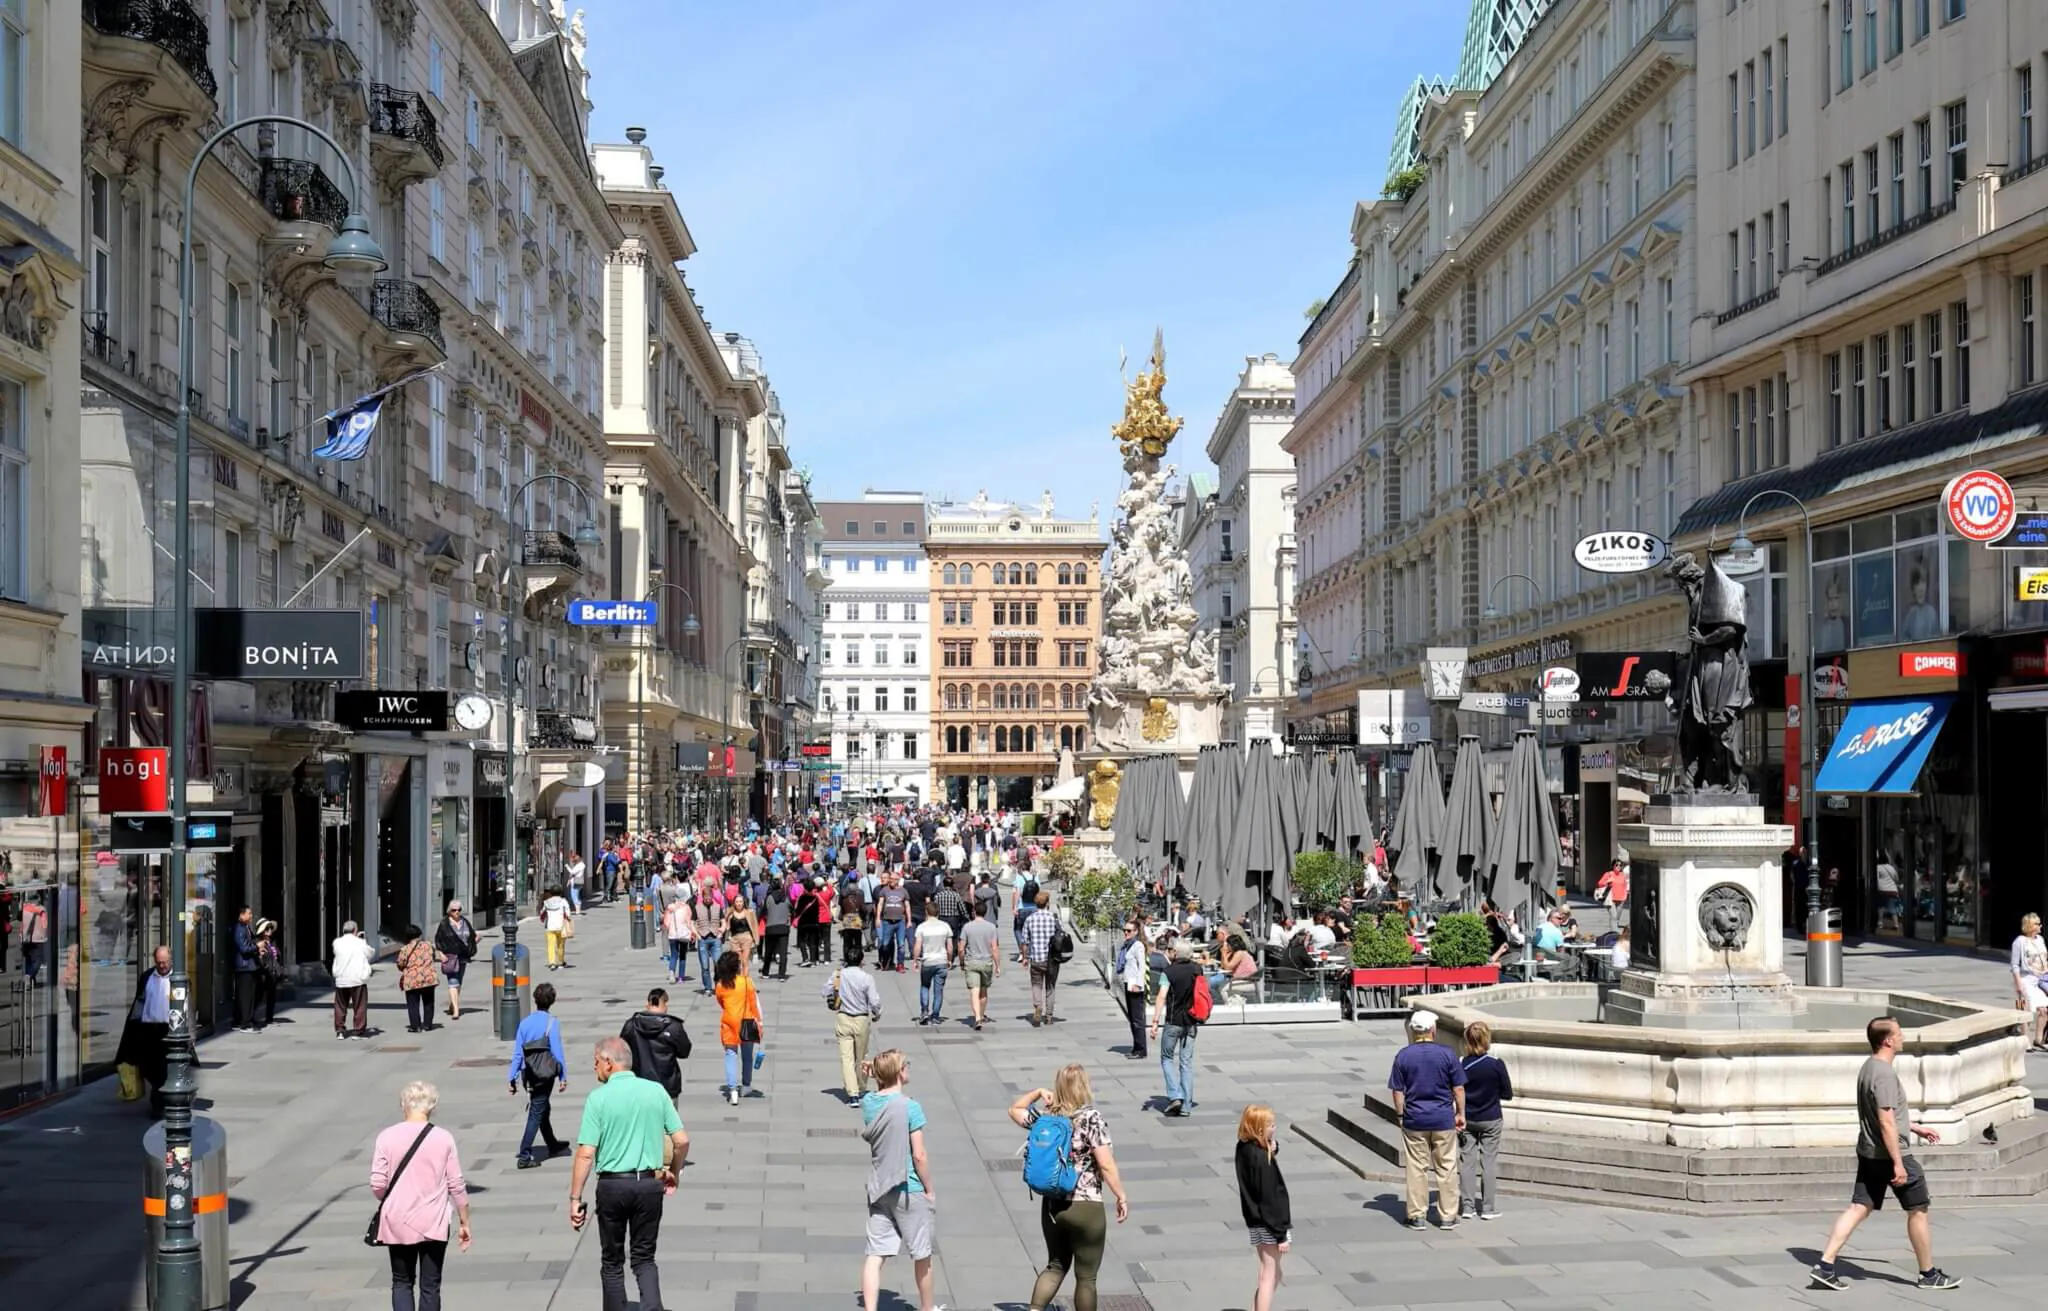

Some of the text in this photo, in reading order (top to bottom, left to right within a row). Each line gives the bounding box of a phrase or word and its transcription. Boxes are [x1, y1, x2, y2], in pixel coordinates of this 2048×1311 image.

[1966, 495, 1998, 518] VVD
[1585, 535, 1656, 555] ZIKOS
[581, 604, 648, 621] Berlitz
[1914, 656, 1957, 672] CAMPER
[378, 697, 418, 713] IWC
[1536, 706, 1588, 719] swatch
[363, 717, 433, 725] SCHAFFHAUSEN
